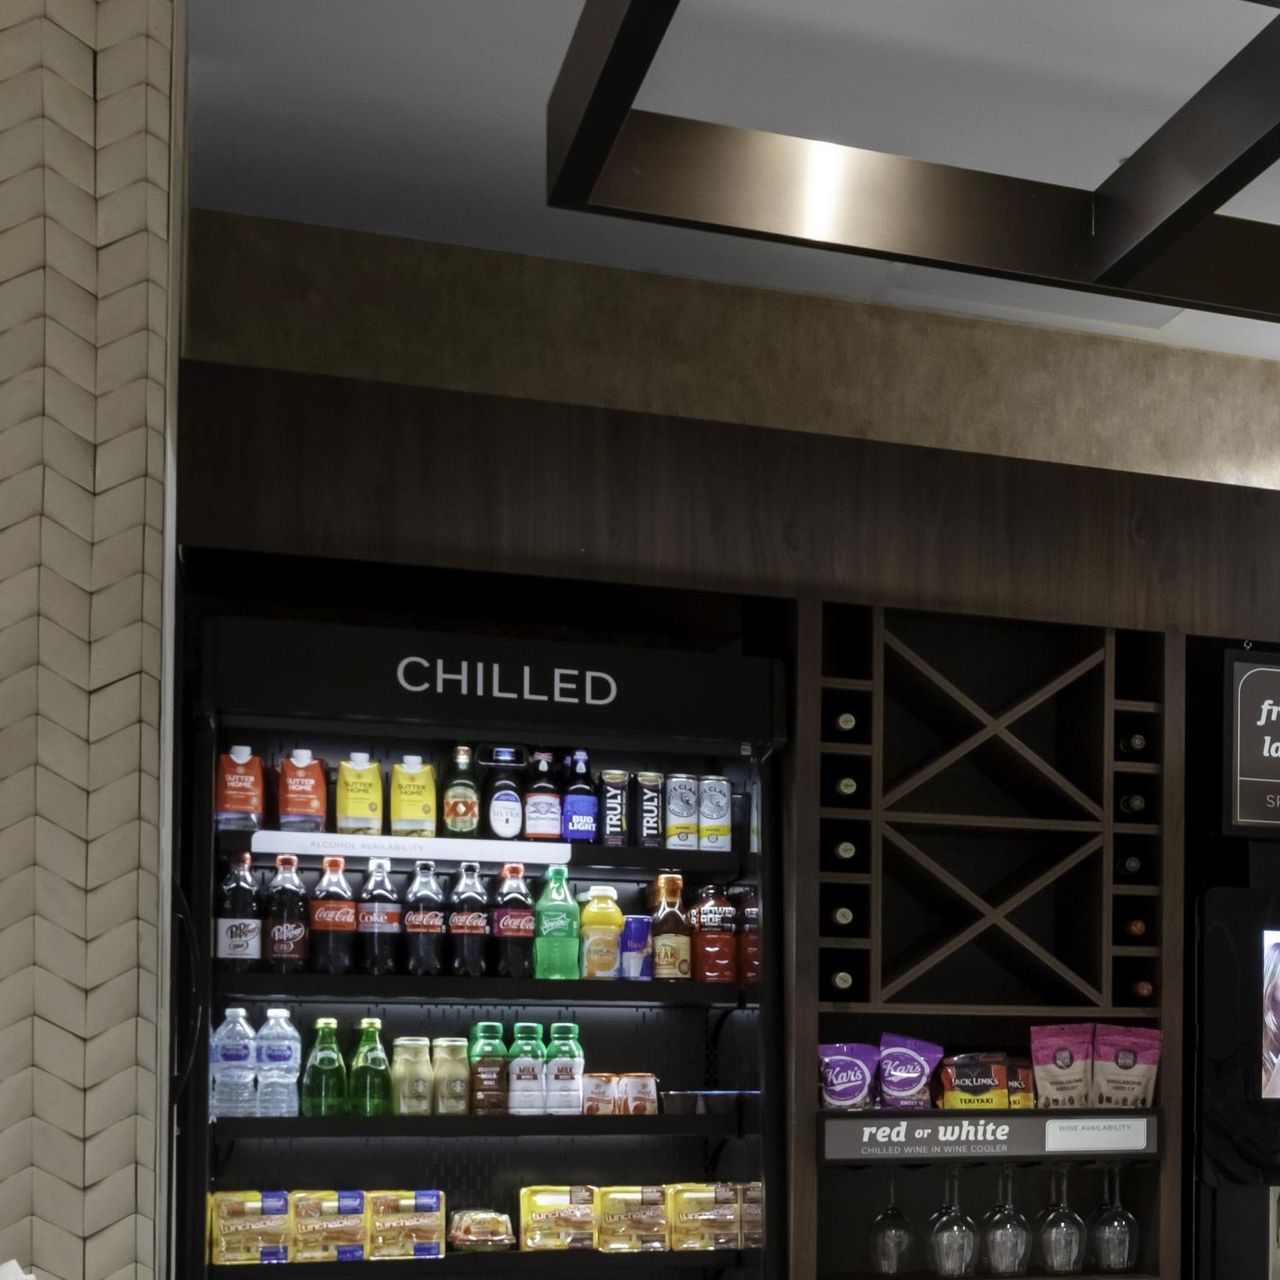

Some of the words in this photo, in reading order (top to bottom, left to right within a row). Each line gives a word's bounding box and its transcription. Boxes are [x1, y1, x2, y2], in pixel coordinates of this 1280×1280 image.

[397, 656, 617, 705] CHILLED
[606, 786, 621, 834] TRULY
[643, 788, 658, 837] TRULY
[571, 815, 594, 823] BUD
[569, 823, 596, 831] LIGHT
[359, 912, 388, 923] Coke
[519, 1066, 536, 1074] MILK
[557, 1066, 574, 1074] MILK
[862, 1121, 907, 1142] red
[915, 1128, 931, 1138] or
[938, 1120, 1009, 1141] white
[861, 1146, 900, 1154] CHILLED
[971, 1144, 1008, 1152] COOLER
